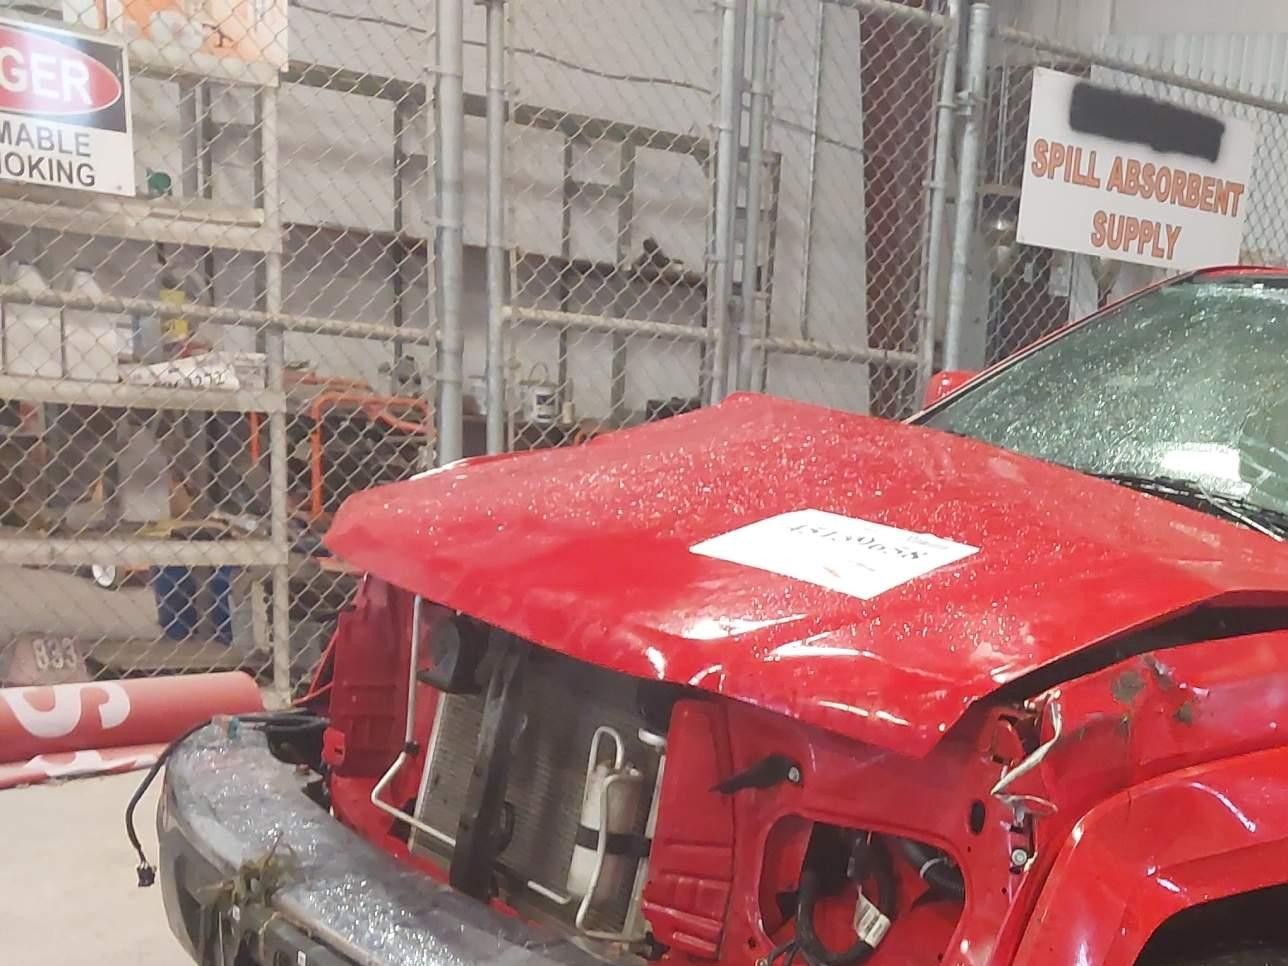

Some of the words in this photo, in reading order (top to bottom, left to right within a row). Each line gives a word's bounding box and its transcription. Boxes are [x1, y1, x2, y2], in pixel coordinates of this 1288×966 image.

[0, 151, 96, 188] OKING
[1031, 138, 1101, 189] SPILL
[1106, 156, 1245, 218] ABSORBENT
[1090, 209, 1182, 260] SUPPLY
